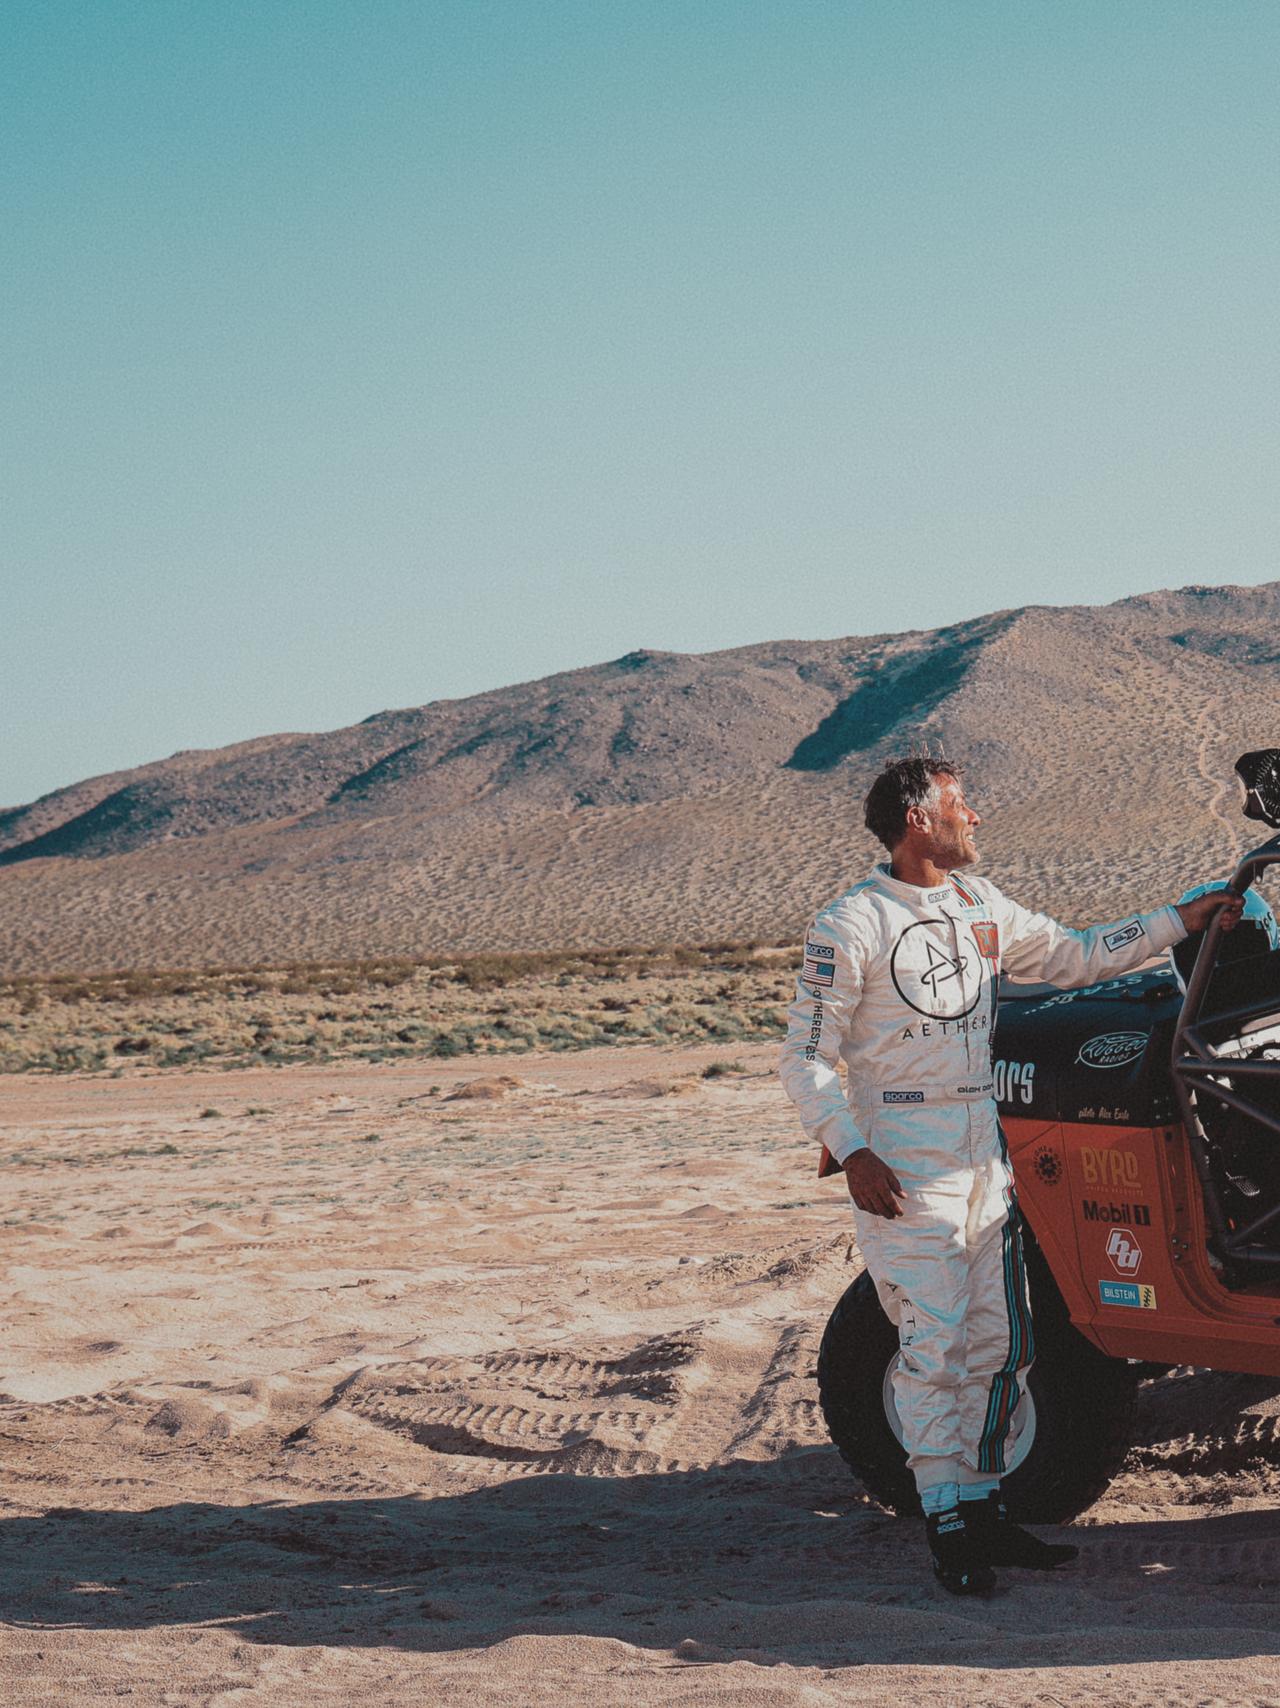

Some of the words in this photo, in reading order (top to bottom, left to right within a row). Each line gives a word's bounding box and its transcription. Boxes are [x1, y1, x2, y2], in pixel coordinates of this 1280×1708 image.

[902, 1015, 988, 1041] AETHER
[884, 1092, 924, 1102] sparco
[1080, 1146, 1142, 1189] BYRD
[1082, 1199, 1132, 1225] Mobil
[1103, 1286, 1137, 1300] BILSTEIN
